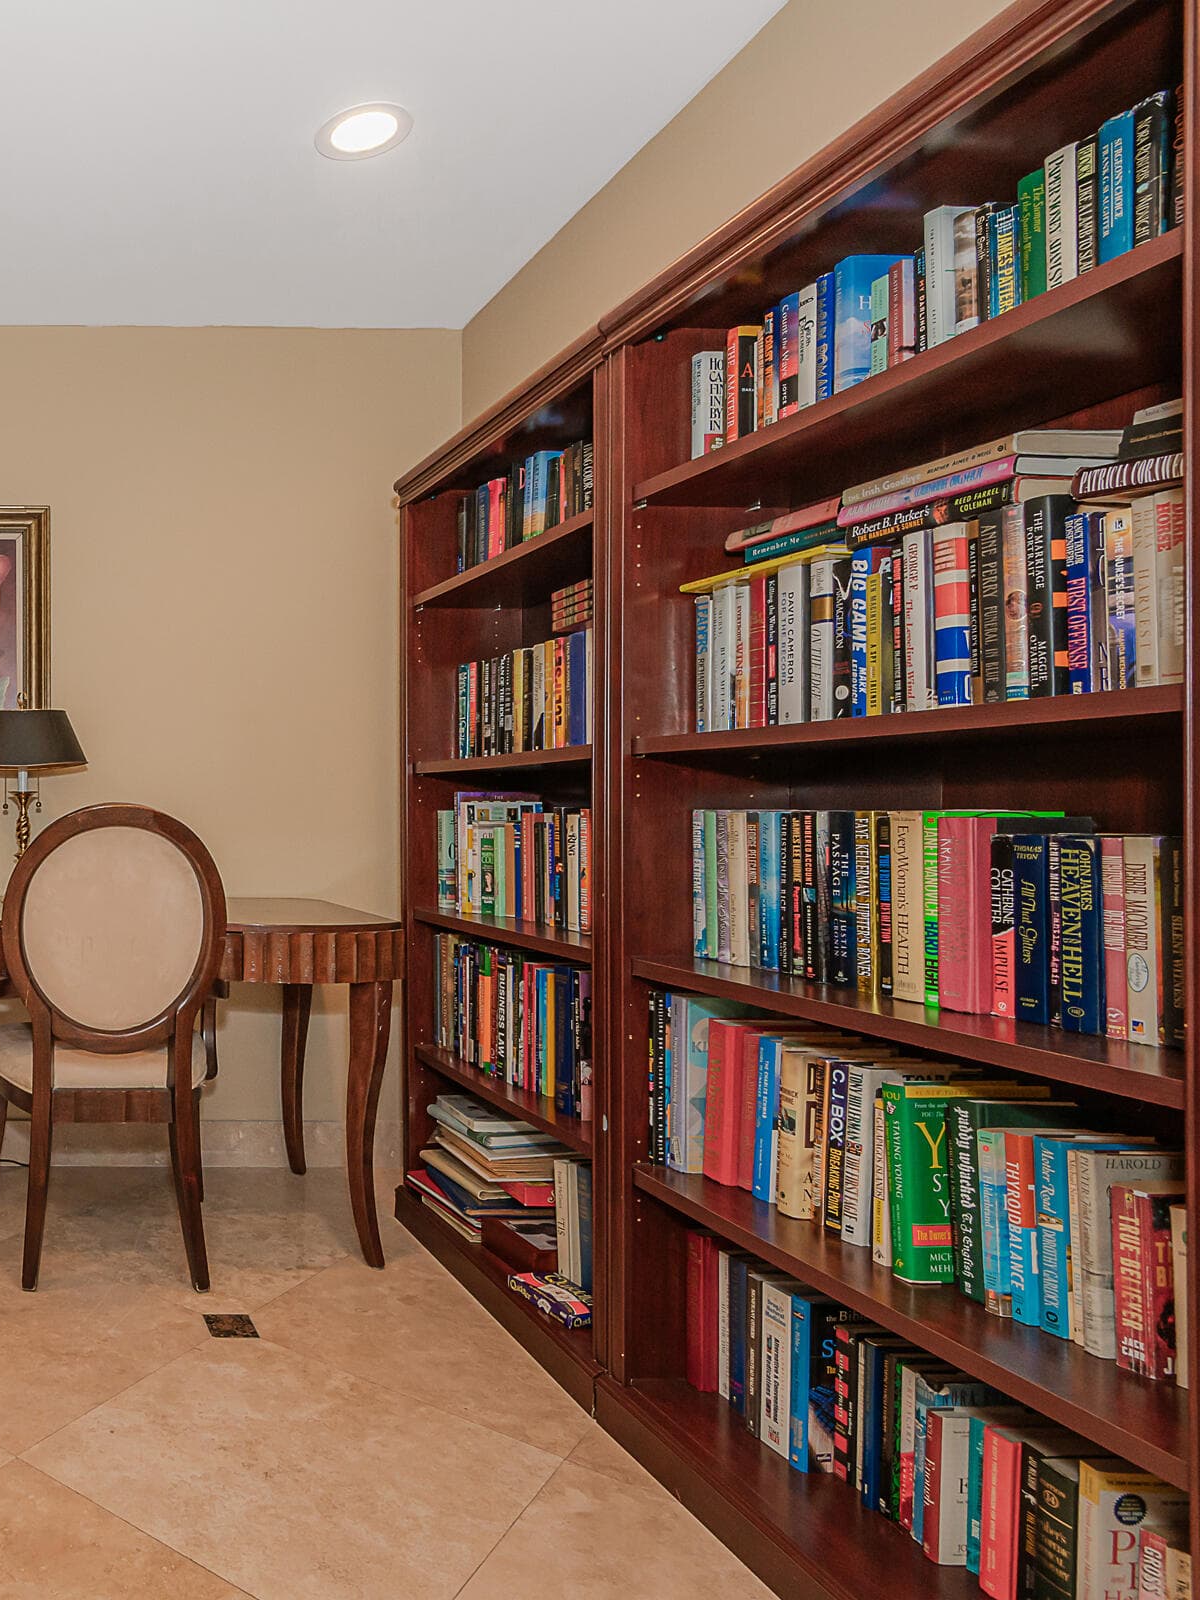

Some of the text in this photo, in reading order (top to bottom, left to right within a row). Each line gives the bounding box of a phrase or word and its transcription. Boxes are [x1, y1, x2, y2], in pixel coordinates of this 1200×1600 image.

[1136, 114, 1152, 149] NORA
[1135, 141, 1151, 185] ROBERTS
[1114, 183, 1123, 222] CHOICE
[726, 342, 736, 428] THE AMATEUR
[851, 504, 930, 538] Robert B. Parker's
[954, 487, 1000, 505] REED FARREL
[959, 497, 992, 512] COLEMAN
[752, 537, 800, 556] Remember Me
[1026, 526, 1034, 578] PORTRAIT
[1033, 510, 1044, 590] THE MARRIAGE
[1156, 502, 1171, 553] HORSE
[767, 579, 776, 642] Killing the Witches
[851, 558, 867, 654] BIG GAME
[981, 524, 999, 683] ANNE PERRY FUNERAL IN BLUE
[1066, 577, 1087, 671] FIRST OFFENSE
[811, 628, 821, 701] ON THE EDGE
[858, 666, 866, 694] MARK
[1029, 633, 1039, 690] O'FARRELL
[1037, 640, 1047, 682] MAGGIE
[568, 834, 576, 856] RING
[831, 833, 840, 897] PASSAGE
[840, 852, 849, 878] THE
[855, 817, 870, 977] FAYE KELLERMAN JUPITER'S BONES
[895, 824, 910, 977] EveryWoman's HEALTH
[923, 825, 939, 993] JANET EVANOVICH HARD EIGHT
[1001, 867, 1014, 926] CATHERINE
[1060, 847, 1080, 937] HEAVEN
[1079, 849, 1092, 912] JOHN JAKES
[1124, 861, 1148, 953] DEBBIE MACOMBER
[832, 917, 840, 957] CRONIN
[839, 919, 847, 958] JUSTIN
[994, 937, 1009, 994] IMPULSE
[1061, 944, 1082, 1005] HELL
[827, 1067, 845, 1217] C. J. BOX BREAKING POINT
[892, 1119, 903, 1199] STAYING YOUNG
[1105, 1158, 1161, 1170] HAROLD
[1040, 1142, 1059, 1309] Mother Road DOROTHY GARLOCK
[1119, 1212, 1143, 1332] TRUE BELIEVER
[1121, 1336, 1144, 1350] JACK
[1121, 1346, 1146, 1362] CARR
[1142, 1542, 1162, 1600] GROSS
